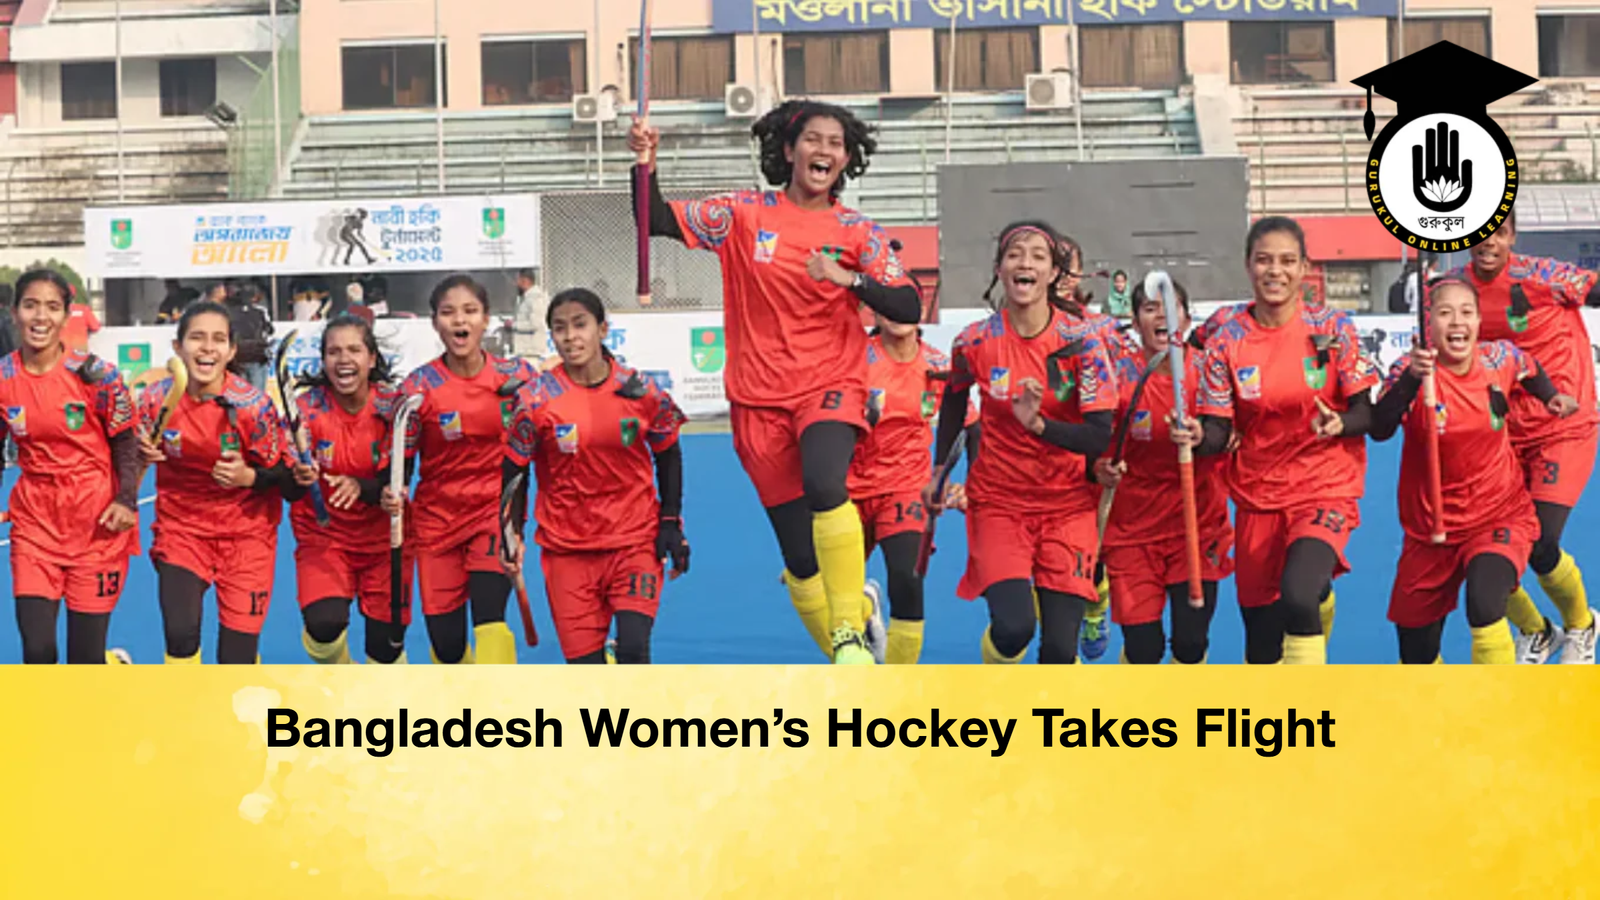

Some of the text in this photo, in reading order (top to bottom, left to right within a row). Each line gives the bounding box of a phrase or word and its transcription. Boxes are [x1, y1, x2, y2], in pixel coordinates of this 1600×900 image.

[1543, 461, 1559, 485] 3
[895, 502, 922, 522] 14
[96, 571, 120, 597] 13
[627, 572, 657, 600] 16
